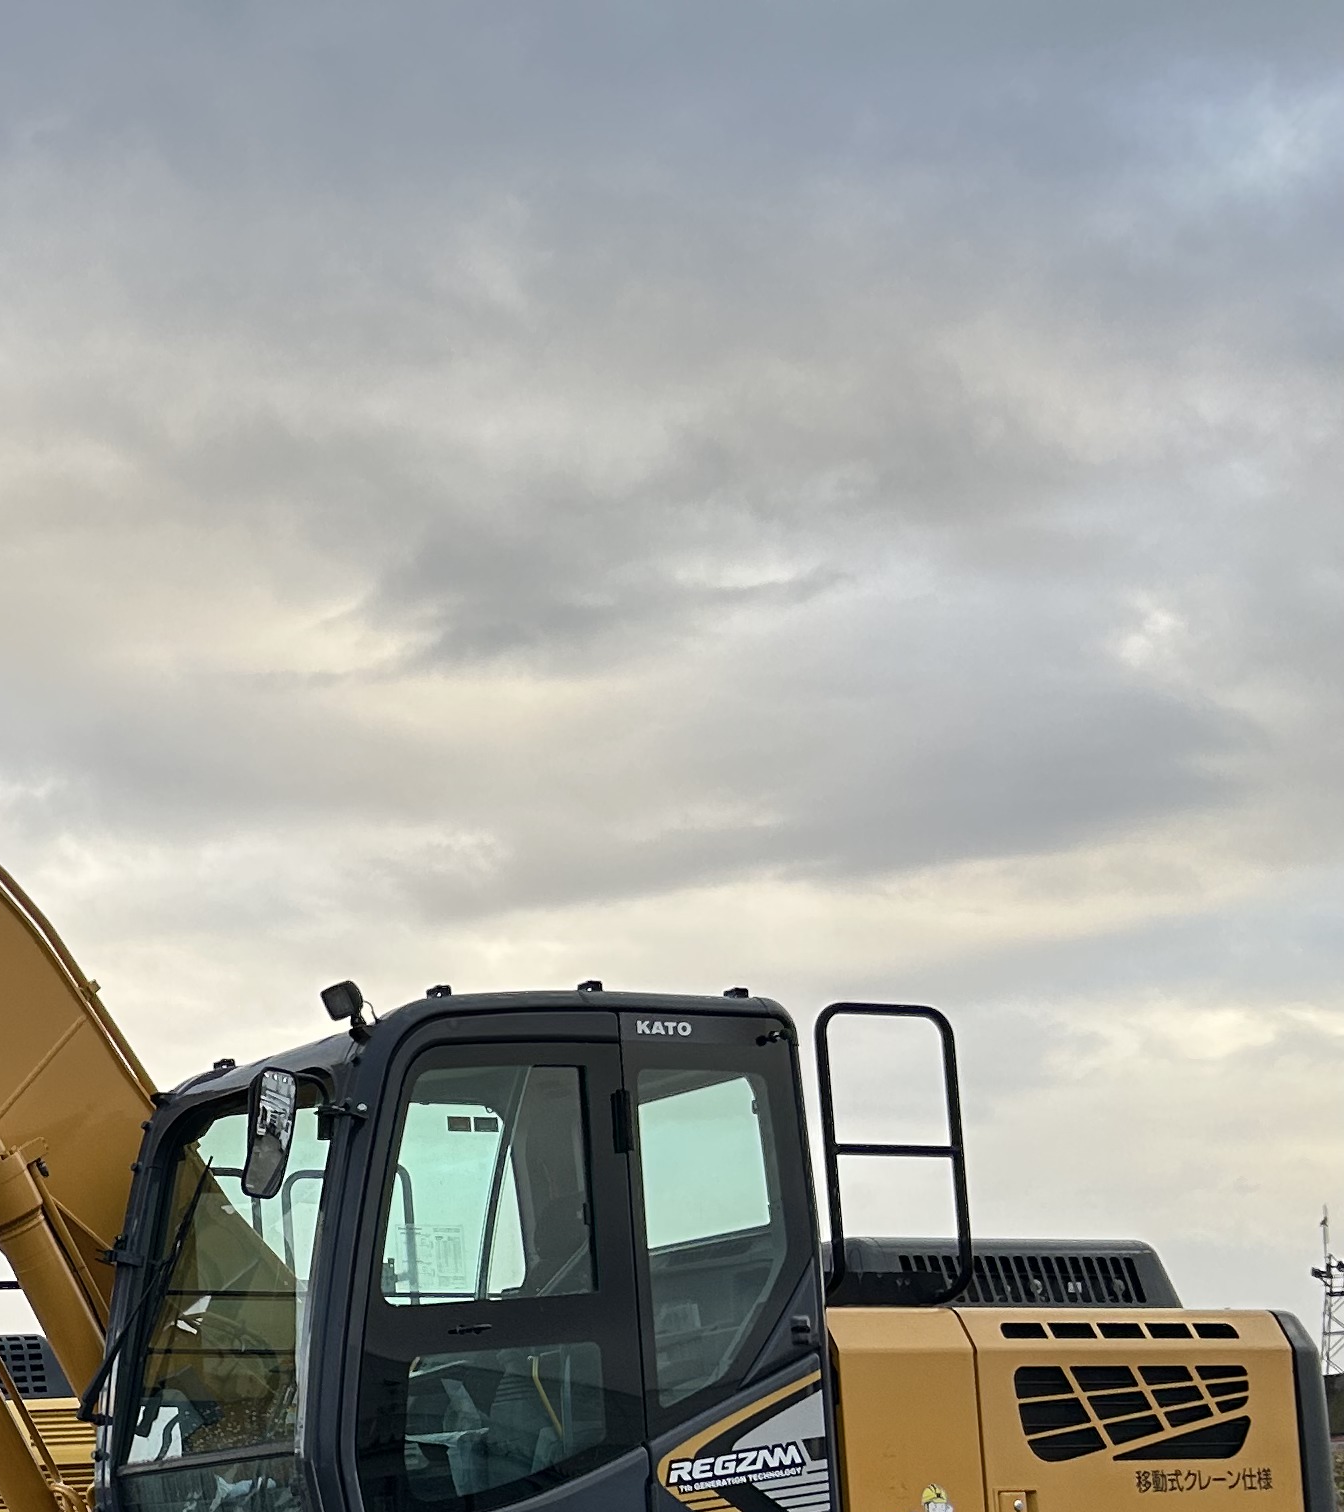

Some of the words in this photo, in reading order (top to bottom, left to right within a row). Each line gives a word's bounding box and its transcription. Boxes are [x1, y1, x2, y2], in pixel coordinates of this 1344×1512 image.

[636, 1020, 692, 1036] KATO
[694, 1476, 747, 1491] GENERATION
[748, 1466, 802, 1482] TECHNOLOGY
[1135, 1467, 1274, 1493] 移動式クレーン仕様
